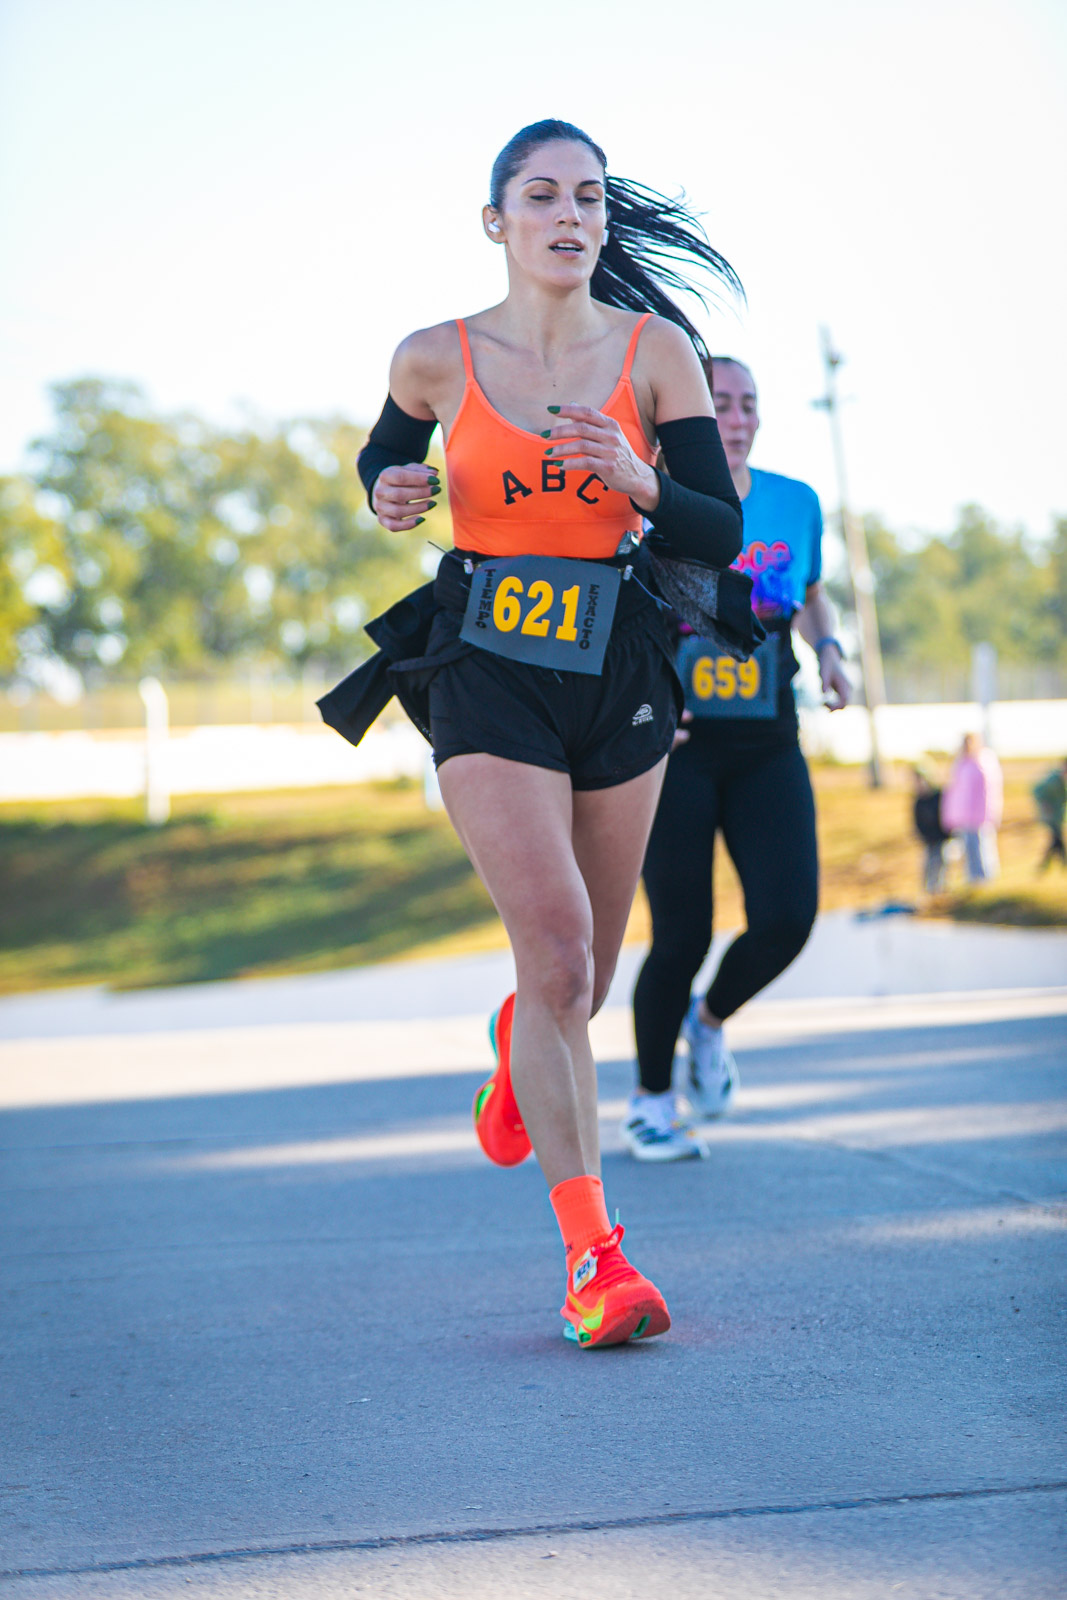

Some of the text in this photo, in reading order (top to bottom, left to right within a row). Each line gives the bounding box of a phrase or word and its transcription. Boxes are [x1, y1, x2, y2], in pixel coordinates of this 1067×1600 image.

[502, 459, 609, 505] ABC
[475, 568, 496, 629] TIEMPO
[493, 575, 580, 642] 621
[579, 584, 600, 650] EXACTO
[692, 655, 761, 700] 659
